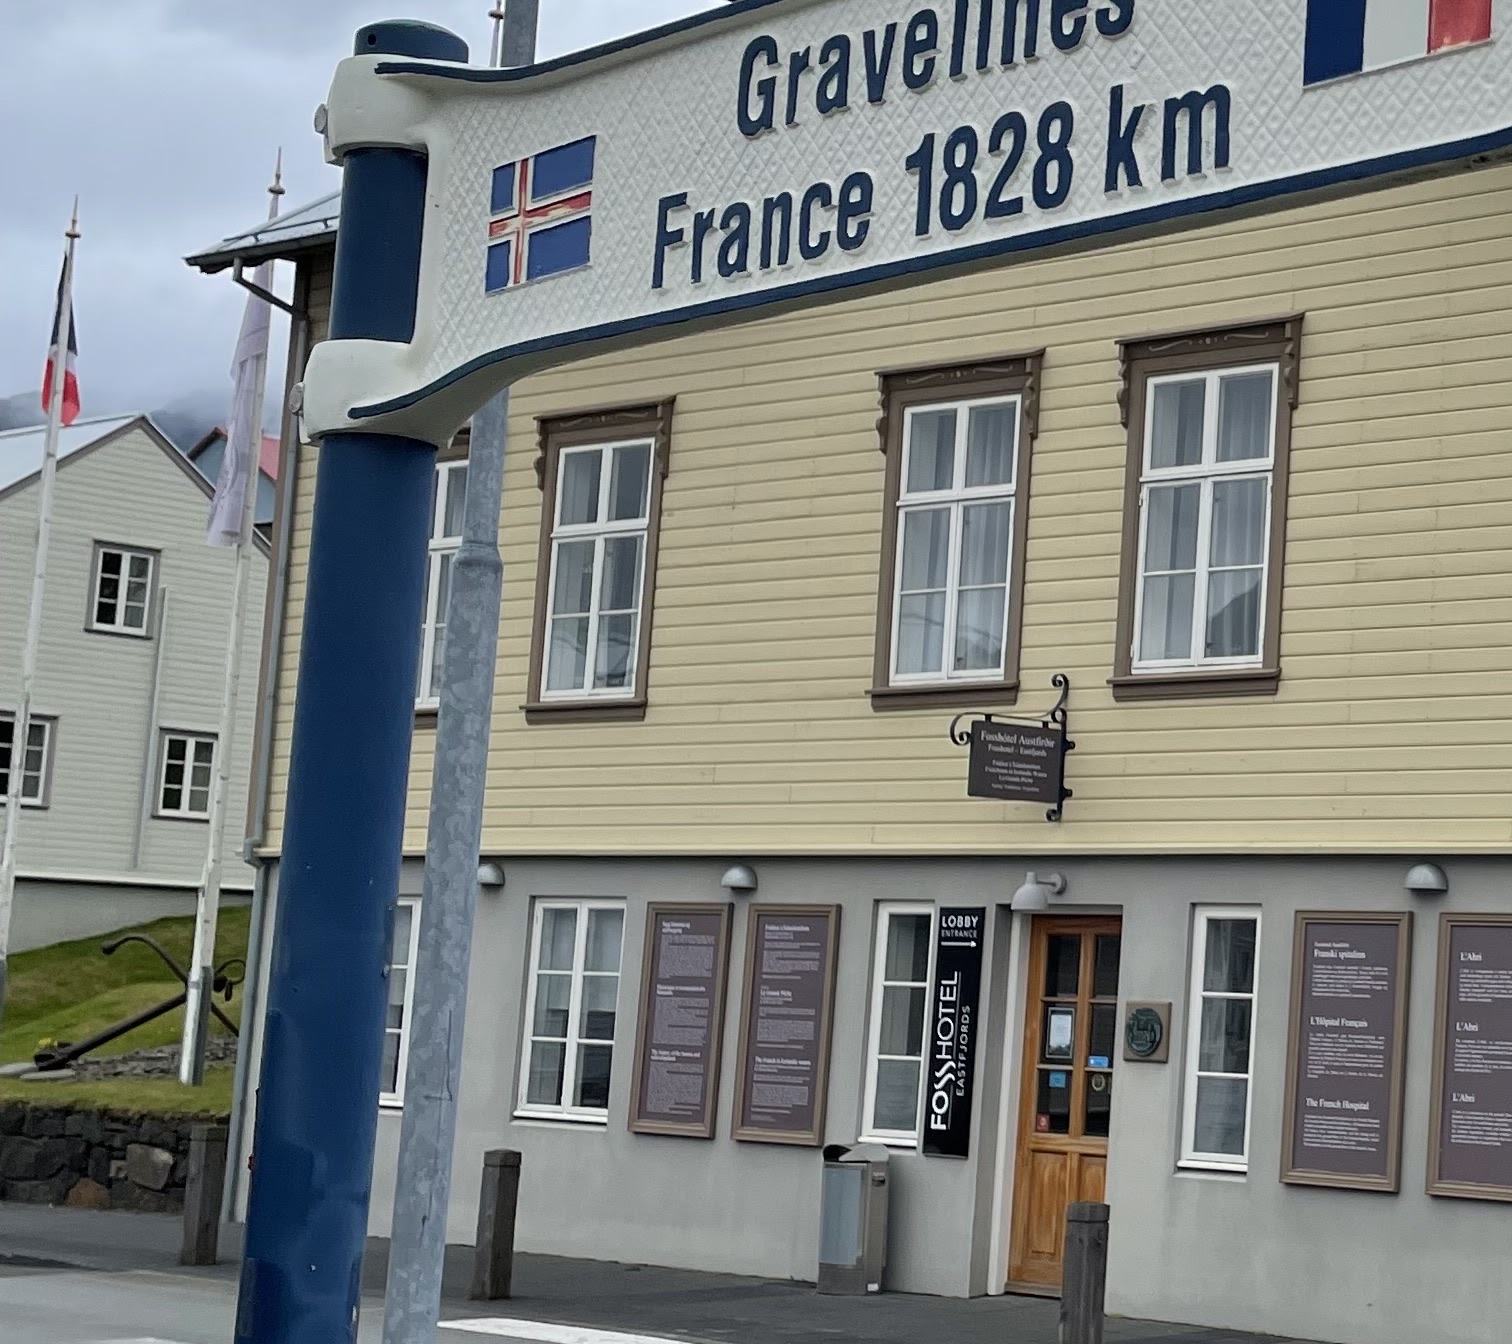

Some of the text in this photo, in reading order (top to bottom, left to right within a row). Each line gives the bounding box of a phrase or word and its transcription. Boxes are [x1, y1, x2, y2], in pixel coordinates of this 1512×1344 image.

[650, 82, 1232, 291] France 1828 km
[940, 929, 978, 939] ENTRANCE
[941, 915, 979, 929] LOBBY
[930, 970, 959, 1131] FOSSHOTEL
[955, 1004, 971, 1097] EASTFJORDS
